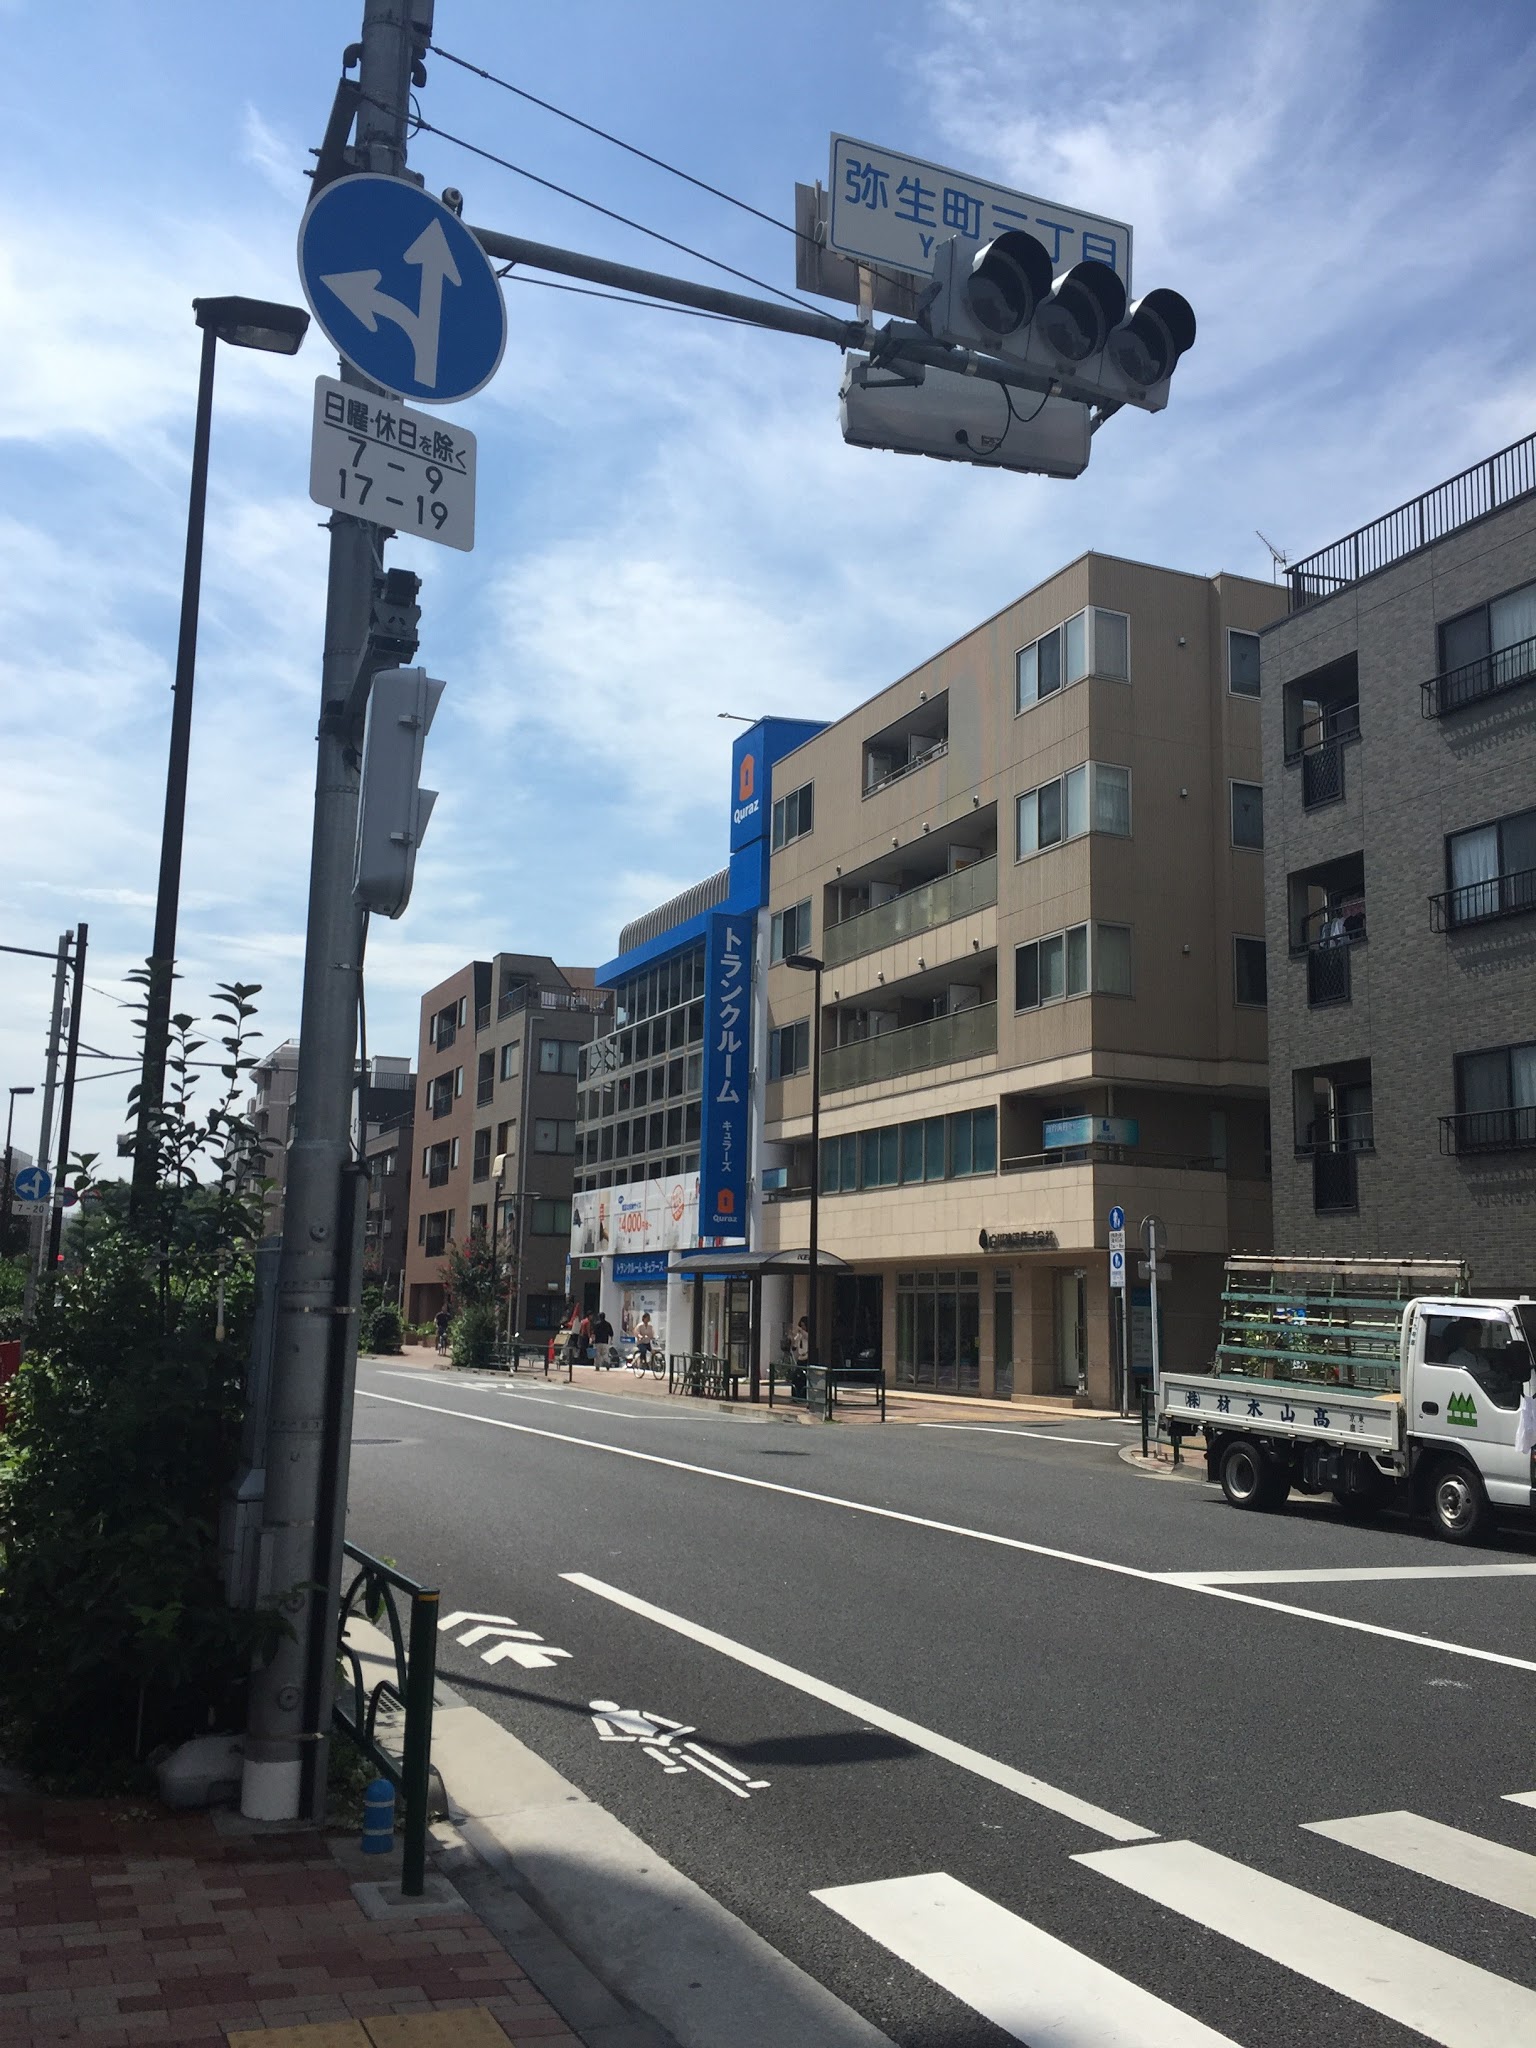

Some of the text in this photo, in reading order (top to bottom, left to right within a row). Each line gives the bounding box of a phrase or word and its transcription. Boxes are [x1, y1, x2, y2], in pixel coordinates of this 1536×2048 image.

[844, 157, 1118, 270] 弥生町三丁目
[734, 797, 760, 825] Quraz
[716, 926, 744, 1104] トランクルーム
[720, 1119, 733, 1173] キュラーズ
[712, 1214, 738, 1223] Quraz
